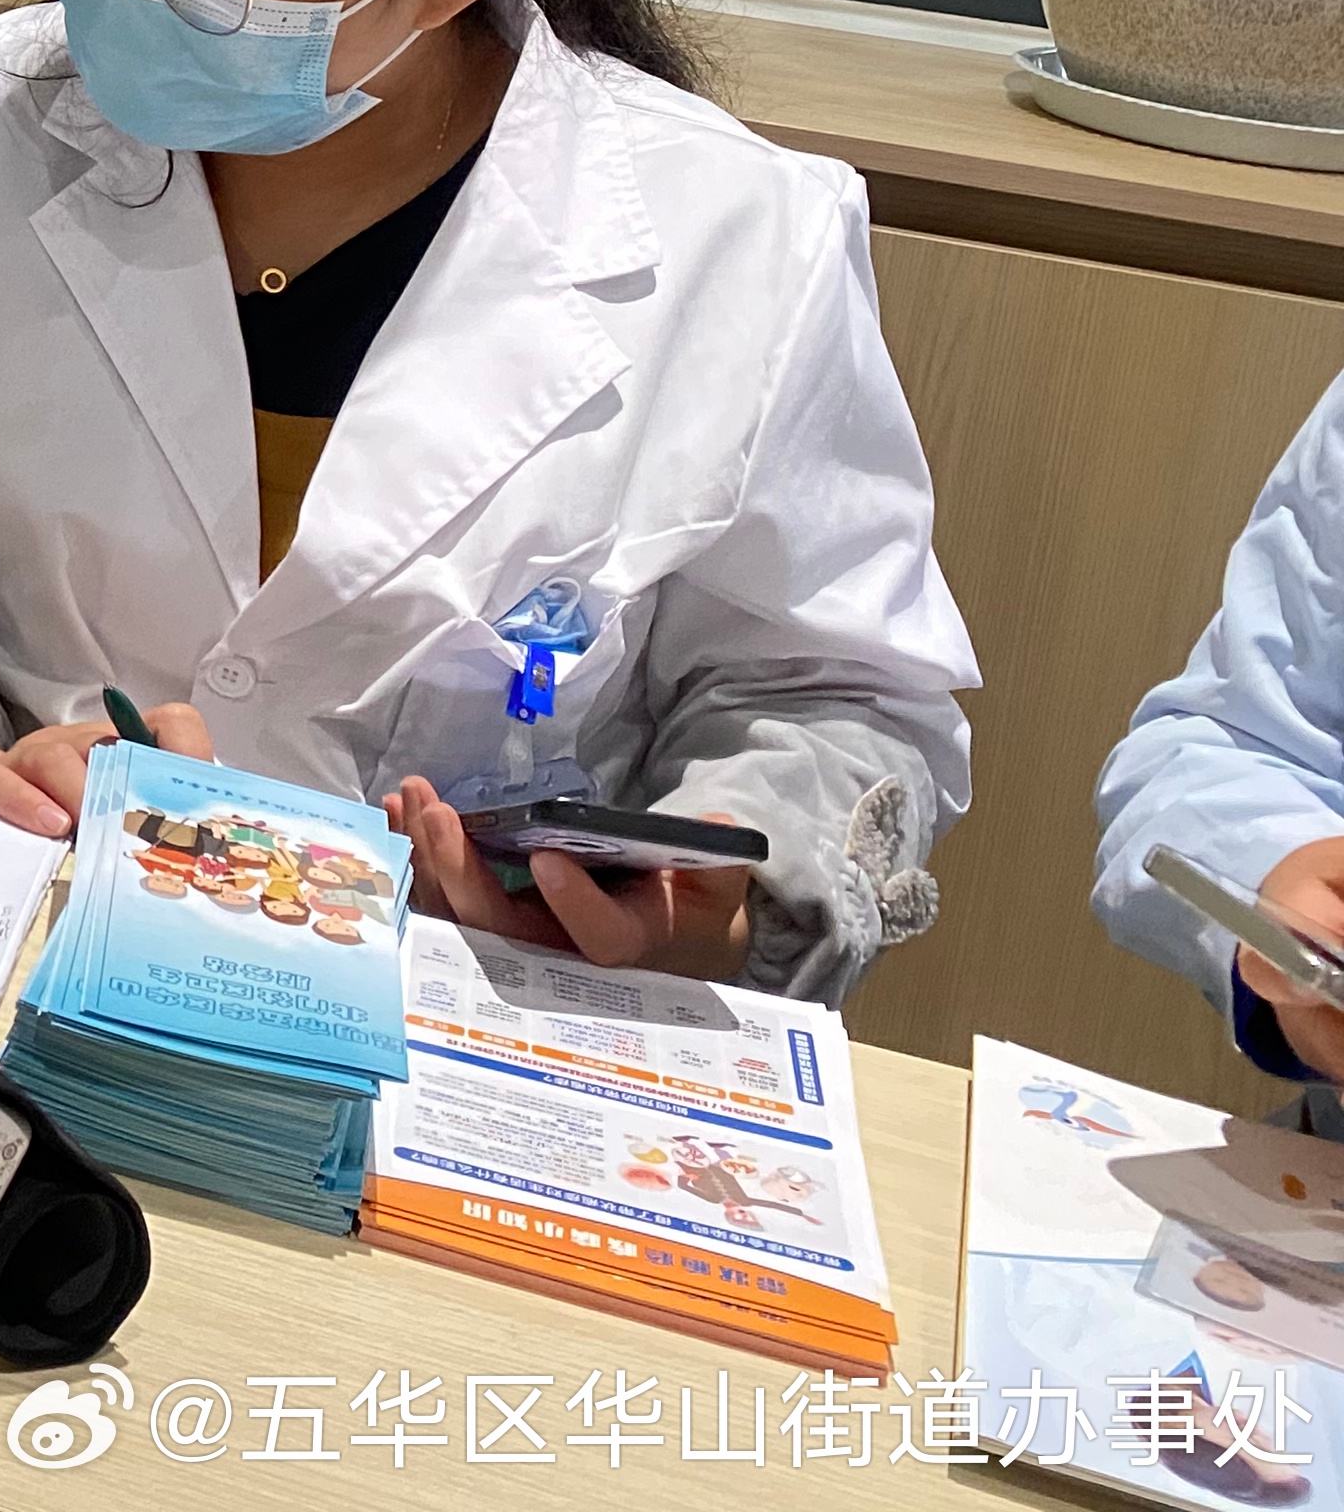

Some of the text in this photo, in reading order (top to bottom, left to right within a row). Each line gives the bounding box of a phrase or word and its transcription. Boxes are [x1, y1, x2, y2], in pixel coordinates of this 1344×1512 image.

[147, 963, 369, 1023] 北门社区卫生
[203, 955, 311, 991] 服务站
[109, 976, 407, 1055] 昆明市五华区华山
